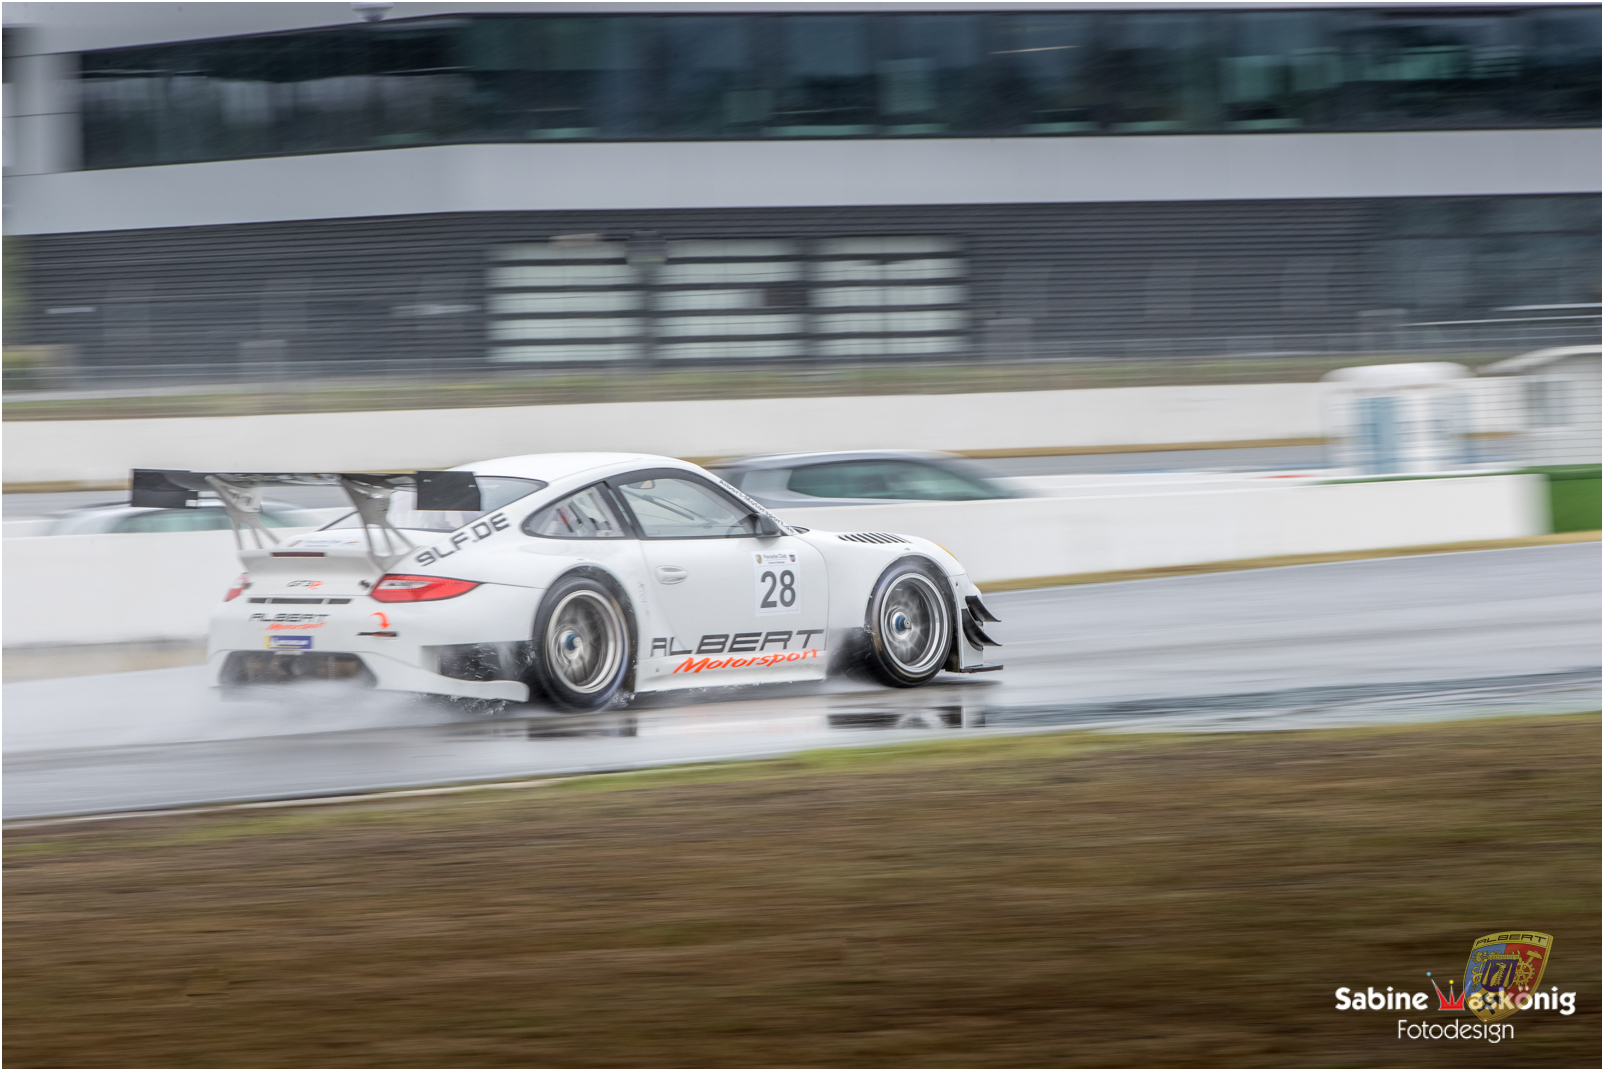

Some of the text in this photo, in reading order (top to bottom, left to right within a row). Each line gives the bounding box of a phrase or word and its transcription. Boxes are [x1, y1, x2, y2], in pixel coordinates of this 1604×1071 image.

[415, 512, 511, 567] 9LF.DE
[760, 569, 796, 609] 28
[247, 612, 331, 622] ALBERT
[650, 629, 825, 657] ALBERT
[672, 648, 820, 674] Motorsport
